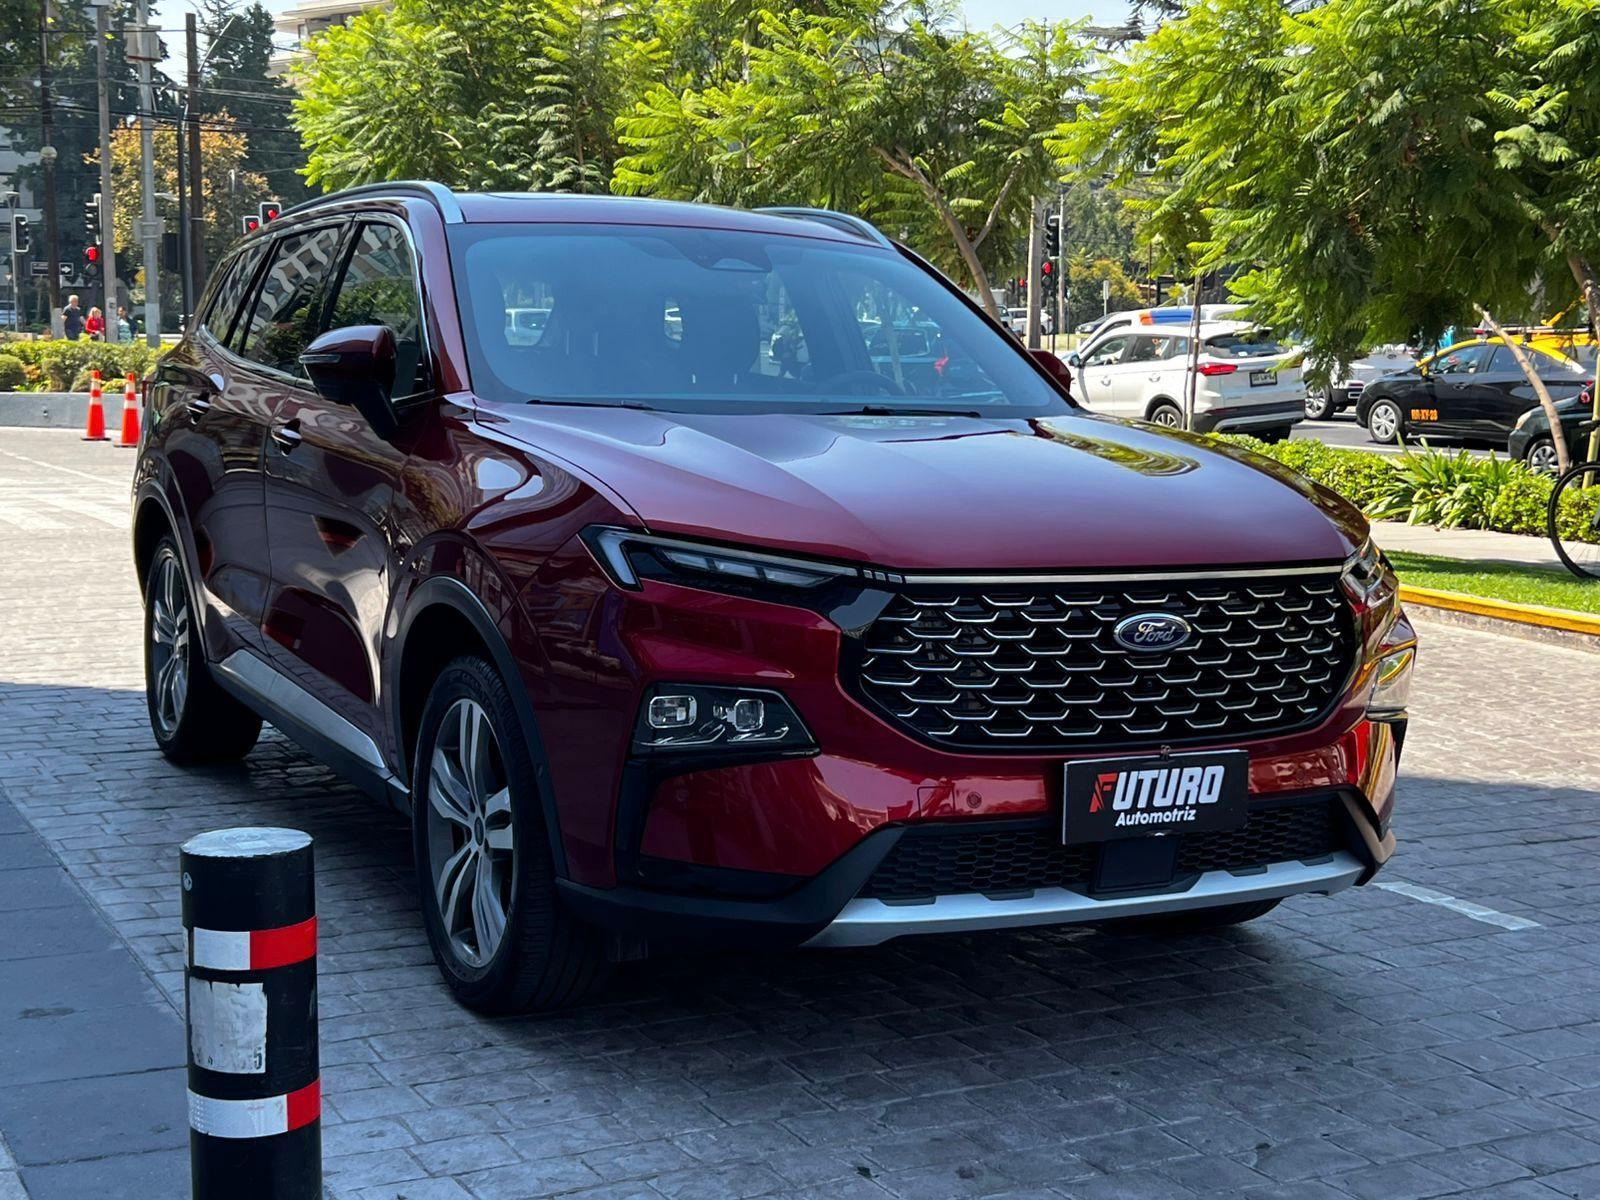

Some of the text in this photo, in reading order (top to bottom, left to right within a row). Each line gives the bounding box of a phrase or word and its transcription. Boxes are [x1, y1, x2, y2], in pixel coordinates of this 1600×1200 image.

[1133, 621, 1176, 643] Ford
[1089, 765, 1225, 813] FUTURO
[1115, 807, 1197, 827] Automotriz
